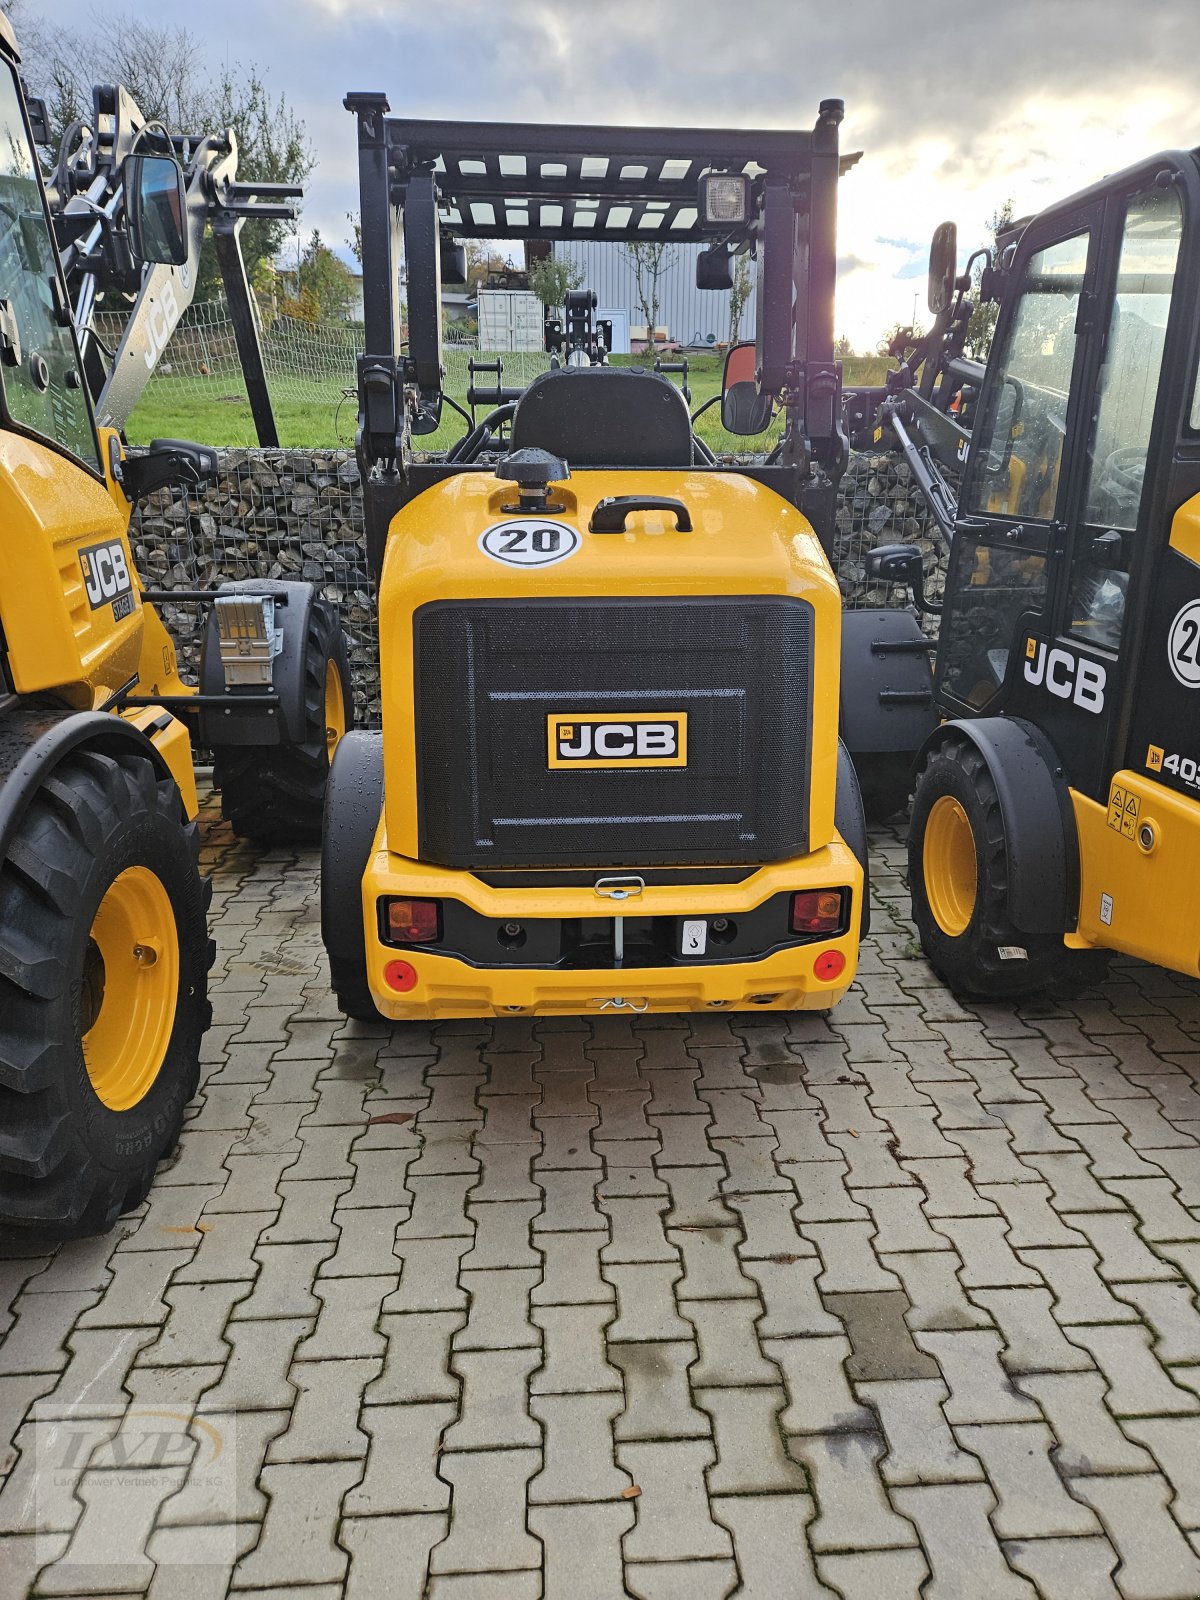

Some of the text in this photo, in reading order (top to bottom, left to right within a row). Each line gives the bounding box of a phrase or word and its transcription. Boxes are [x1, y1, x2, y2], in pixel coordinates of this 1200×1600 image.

[144, 280, 179, 370] JCB
[498, 528, 561, 553] 20
[86, 544, 131, 604] JCB
[1177, 619, 1200, 667] 2
[1023, 642, 1108, 714] JCB
[560, 724, 676, 757] JCB
